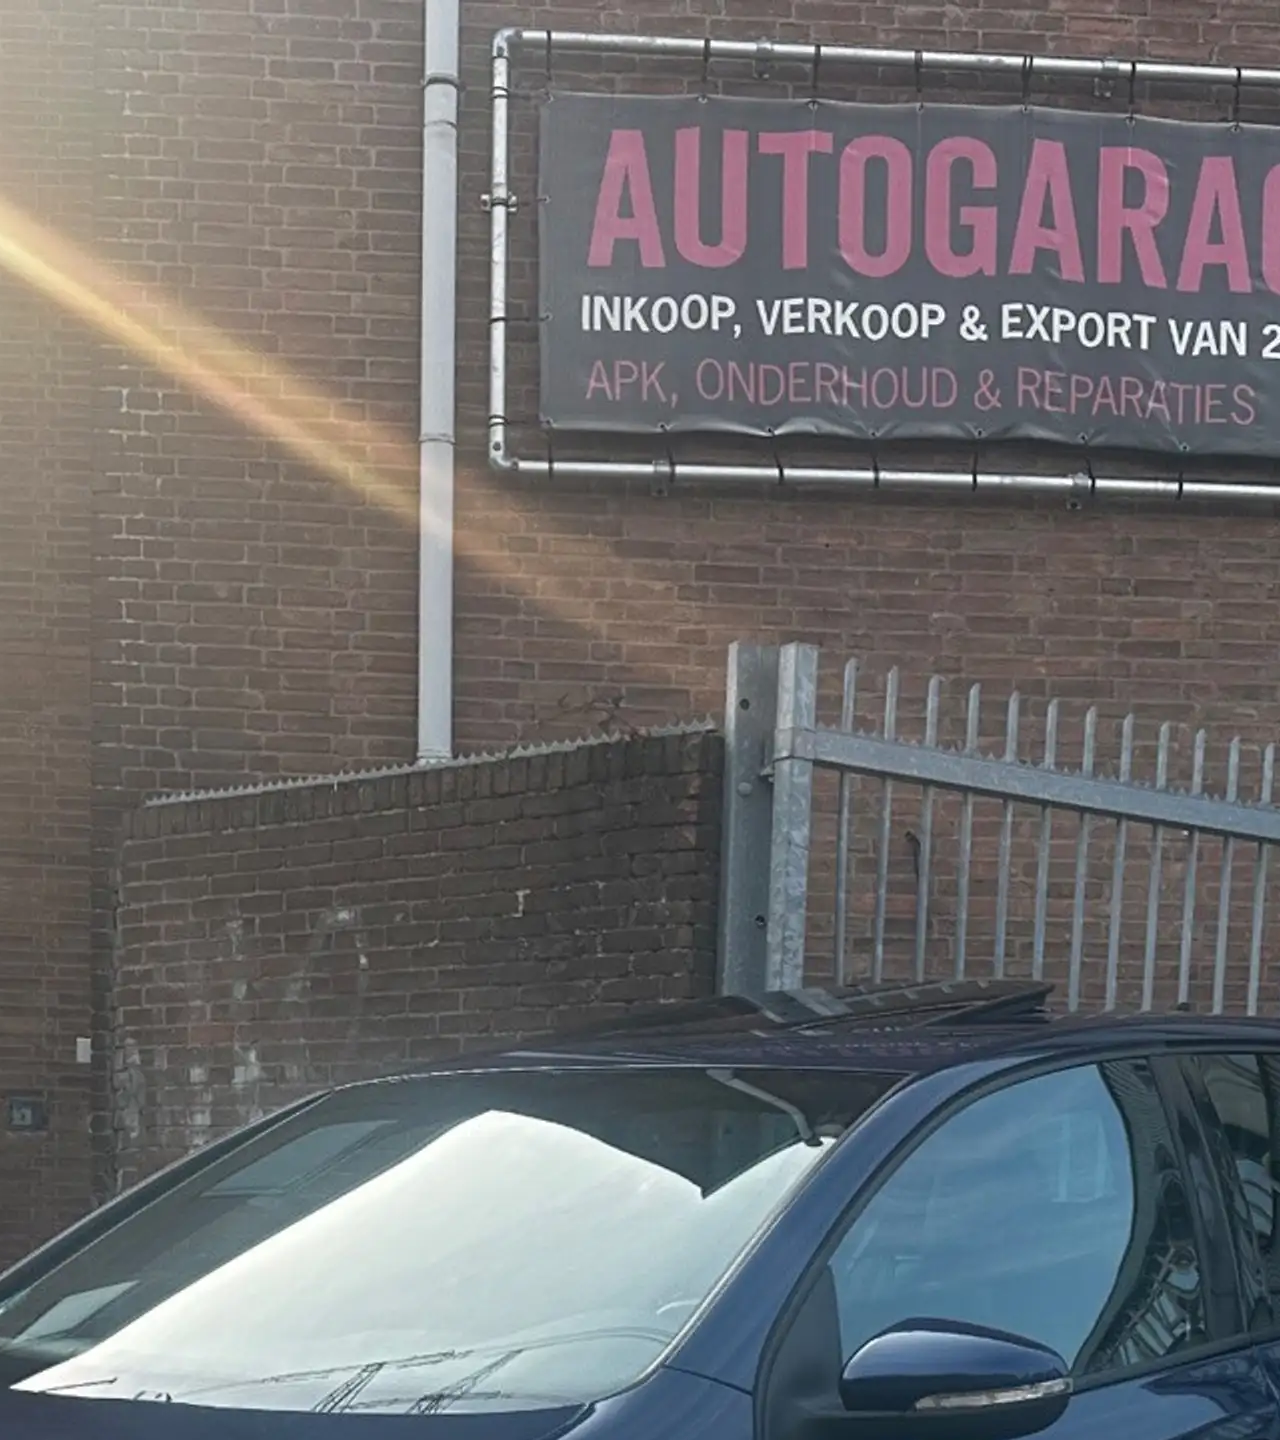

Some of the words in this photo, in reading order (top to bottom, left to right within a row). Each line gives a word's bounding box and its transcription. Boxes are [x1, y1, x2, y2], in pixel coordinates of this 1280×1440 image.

[581, 294, 742, 339] INKOOP,
[756, 298, 946, 341] VERKOOP
[959, 304, 989, 342] &
[1001, 302, 1157, 350] EXPORT
[1168, 318, 1248, 357] VAN
[585, 359, 678, 409] APK,
[696, 357, 958, 409] ONDERHOUD
[973, 368, 1003, 411] &
[1018, 365, 1257, 427] REPARATIES
